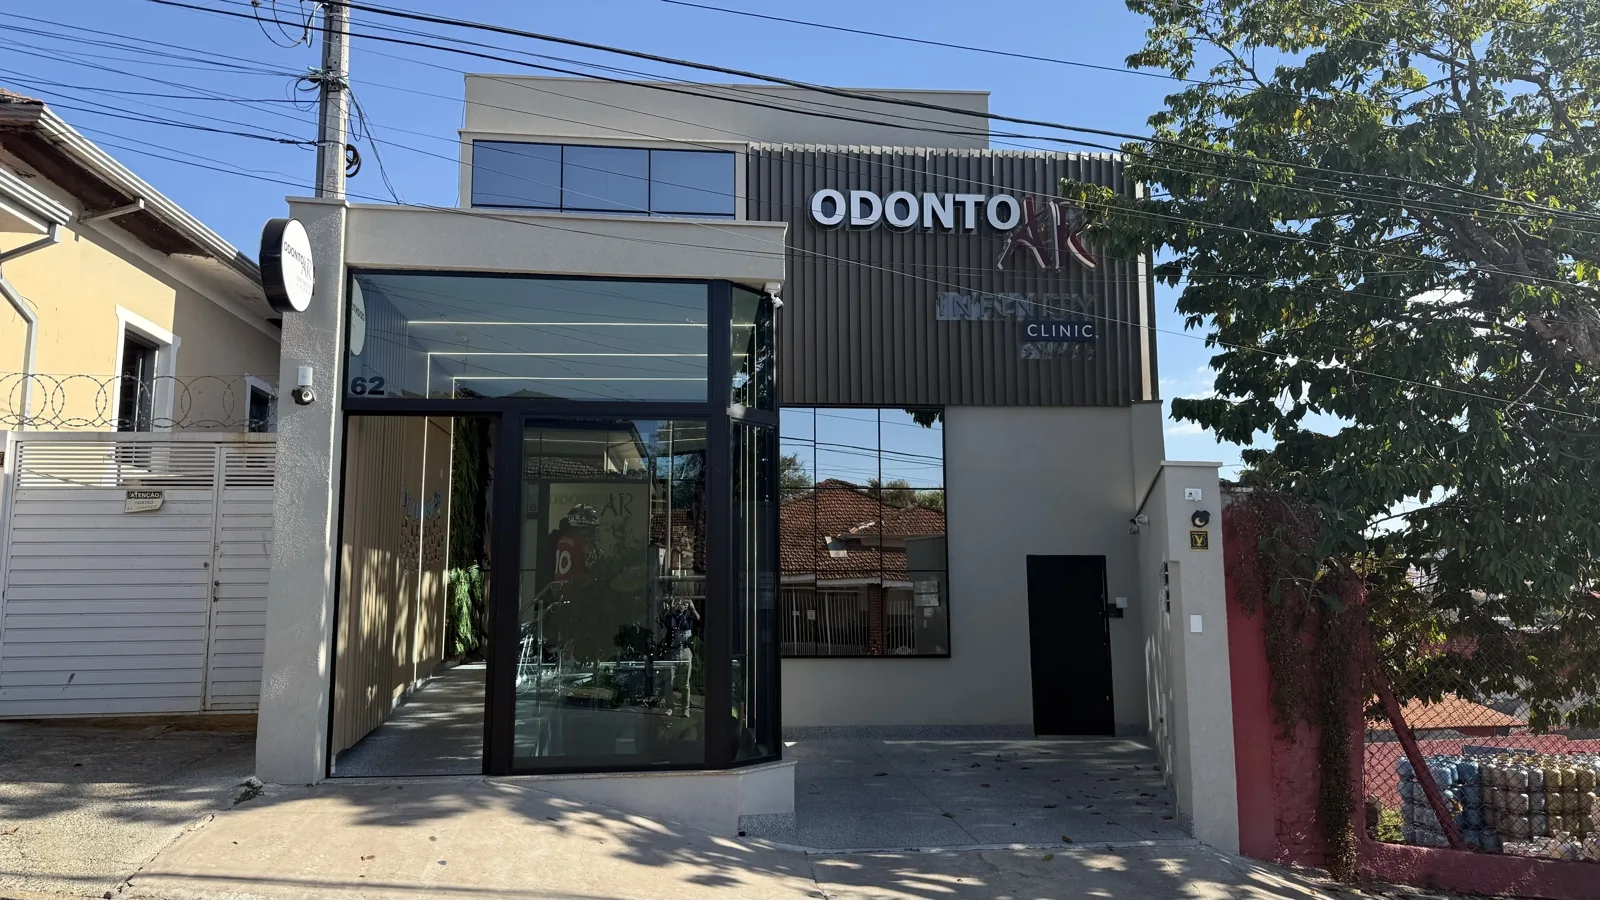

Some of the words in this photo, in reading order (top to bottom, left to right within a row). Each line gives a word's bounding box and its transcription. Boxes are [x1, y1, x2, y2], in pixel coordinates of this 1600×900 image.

[811, 188, 1021, 230] ODONTO
[284, 241, 304, 265] ODONTO
[1027, 323, 1093, 338] CLINIC
[351, 377, 385, 396] 62
[600, 492, 633, 516] AR
[555, 549, 572, 575] 10
